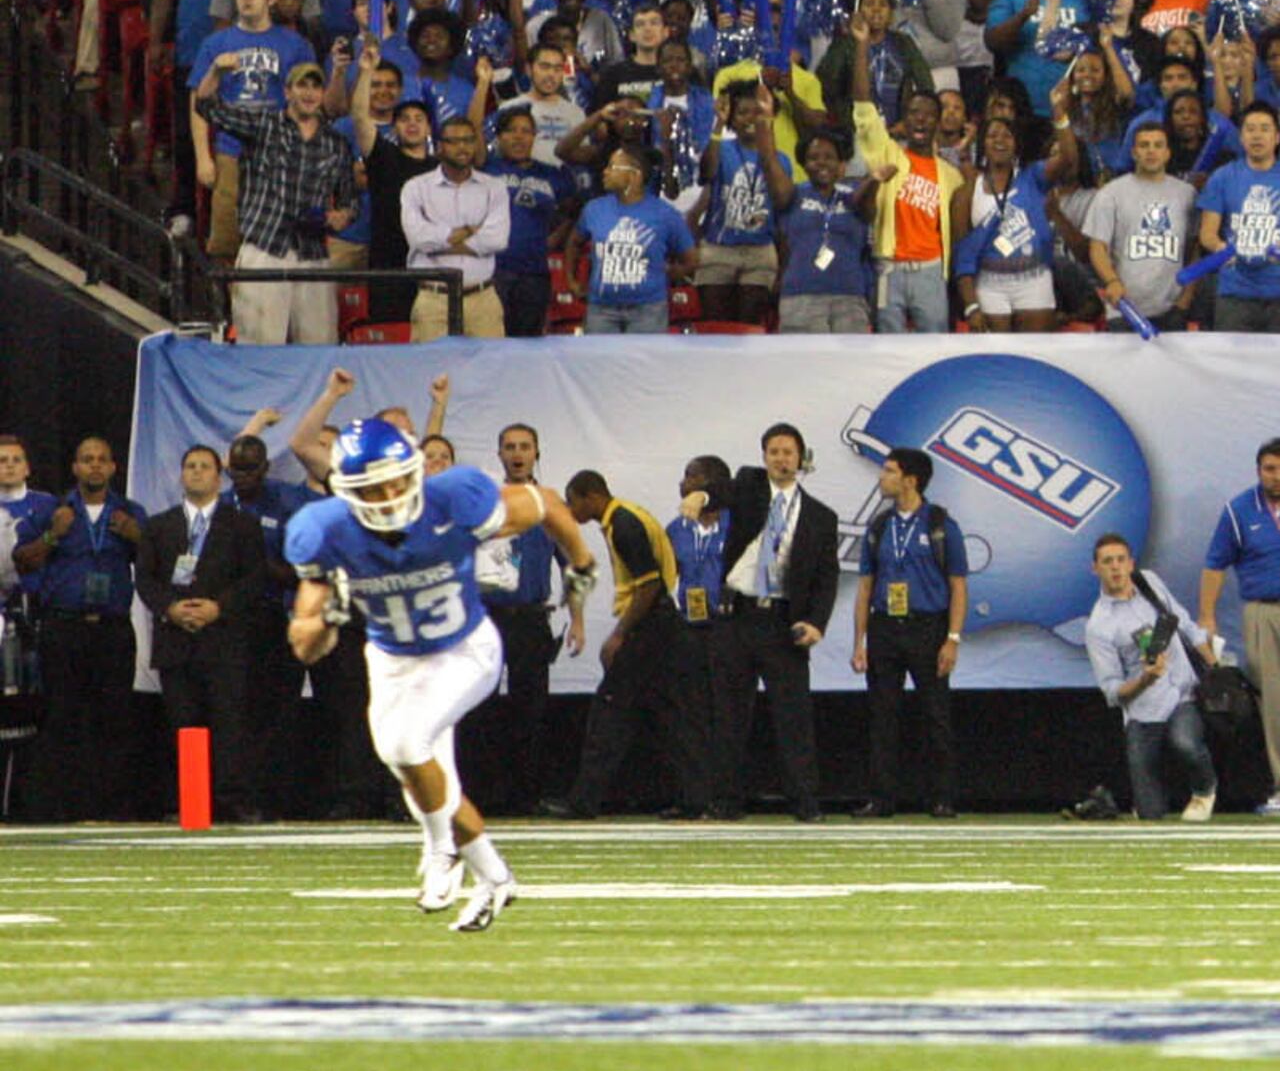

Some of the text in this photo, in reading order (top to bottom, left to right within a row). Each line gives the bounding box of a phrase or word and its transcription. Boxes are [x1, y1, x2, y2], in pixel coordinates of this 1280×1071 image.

[1231, 213, 1278, 232] BLEED
[596, 242, 643, 260] BLEED
[1129, 234, 1183, 263] GSU
[601, 257, 649, 278] BLUE
[938, 410, 1110, 519] GSU
[349, 561, 456, 596] PANTHERS
[353, 580, 467, 644] 43
